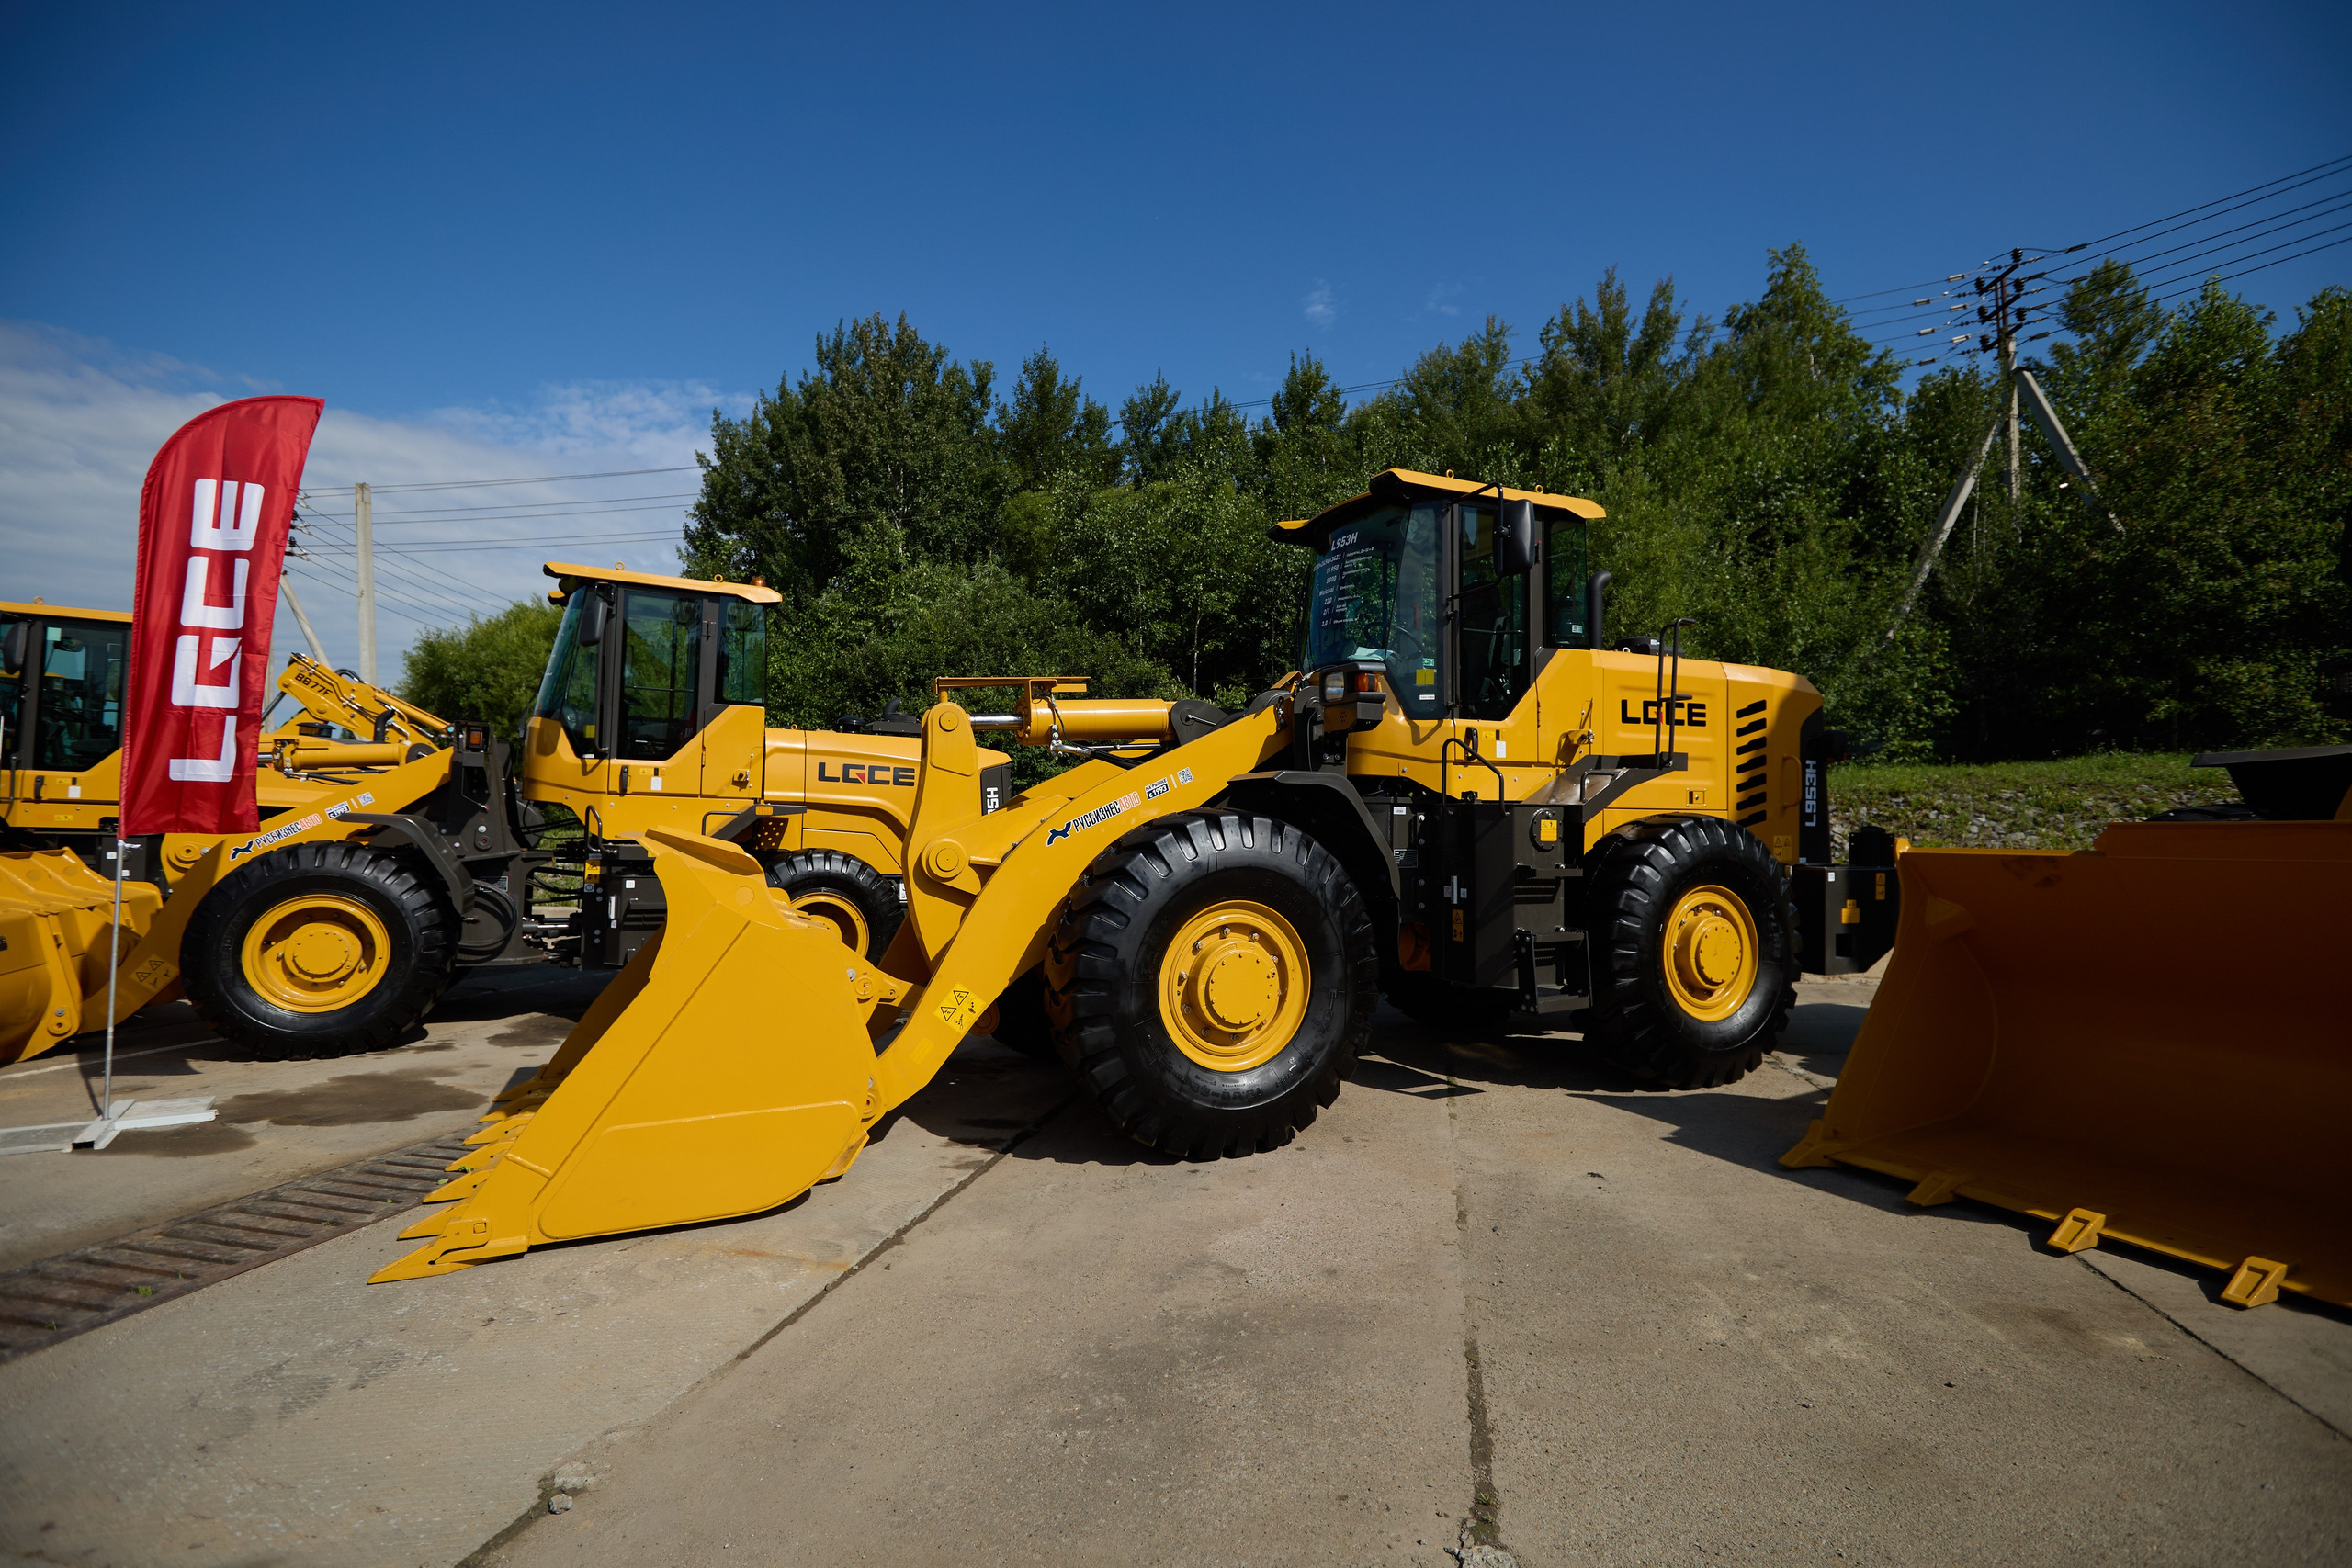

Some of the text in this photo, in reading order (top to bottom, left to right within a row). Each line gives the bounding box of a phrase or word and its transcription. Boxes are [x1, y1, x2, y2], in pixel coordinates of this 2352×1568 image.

[1331, 532, 1358, 551] L953H
[169, 479, 265, 782] LGCE
[1621, 698, 1707, 727] LGCE
[818, 761, 915, 786] LGCE
[1153, 784, 1168, 796] 1993
[1805, 760, 1817, 827] L953H
[1072, 791, 1141, 832] РУСБИЗНЕСАВТО
